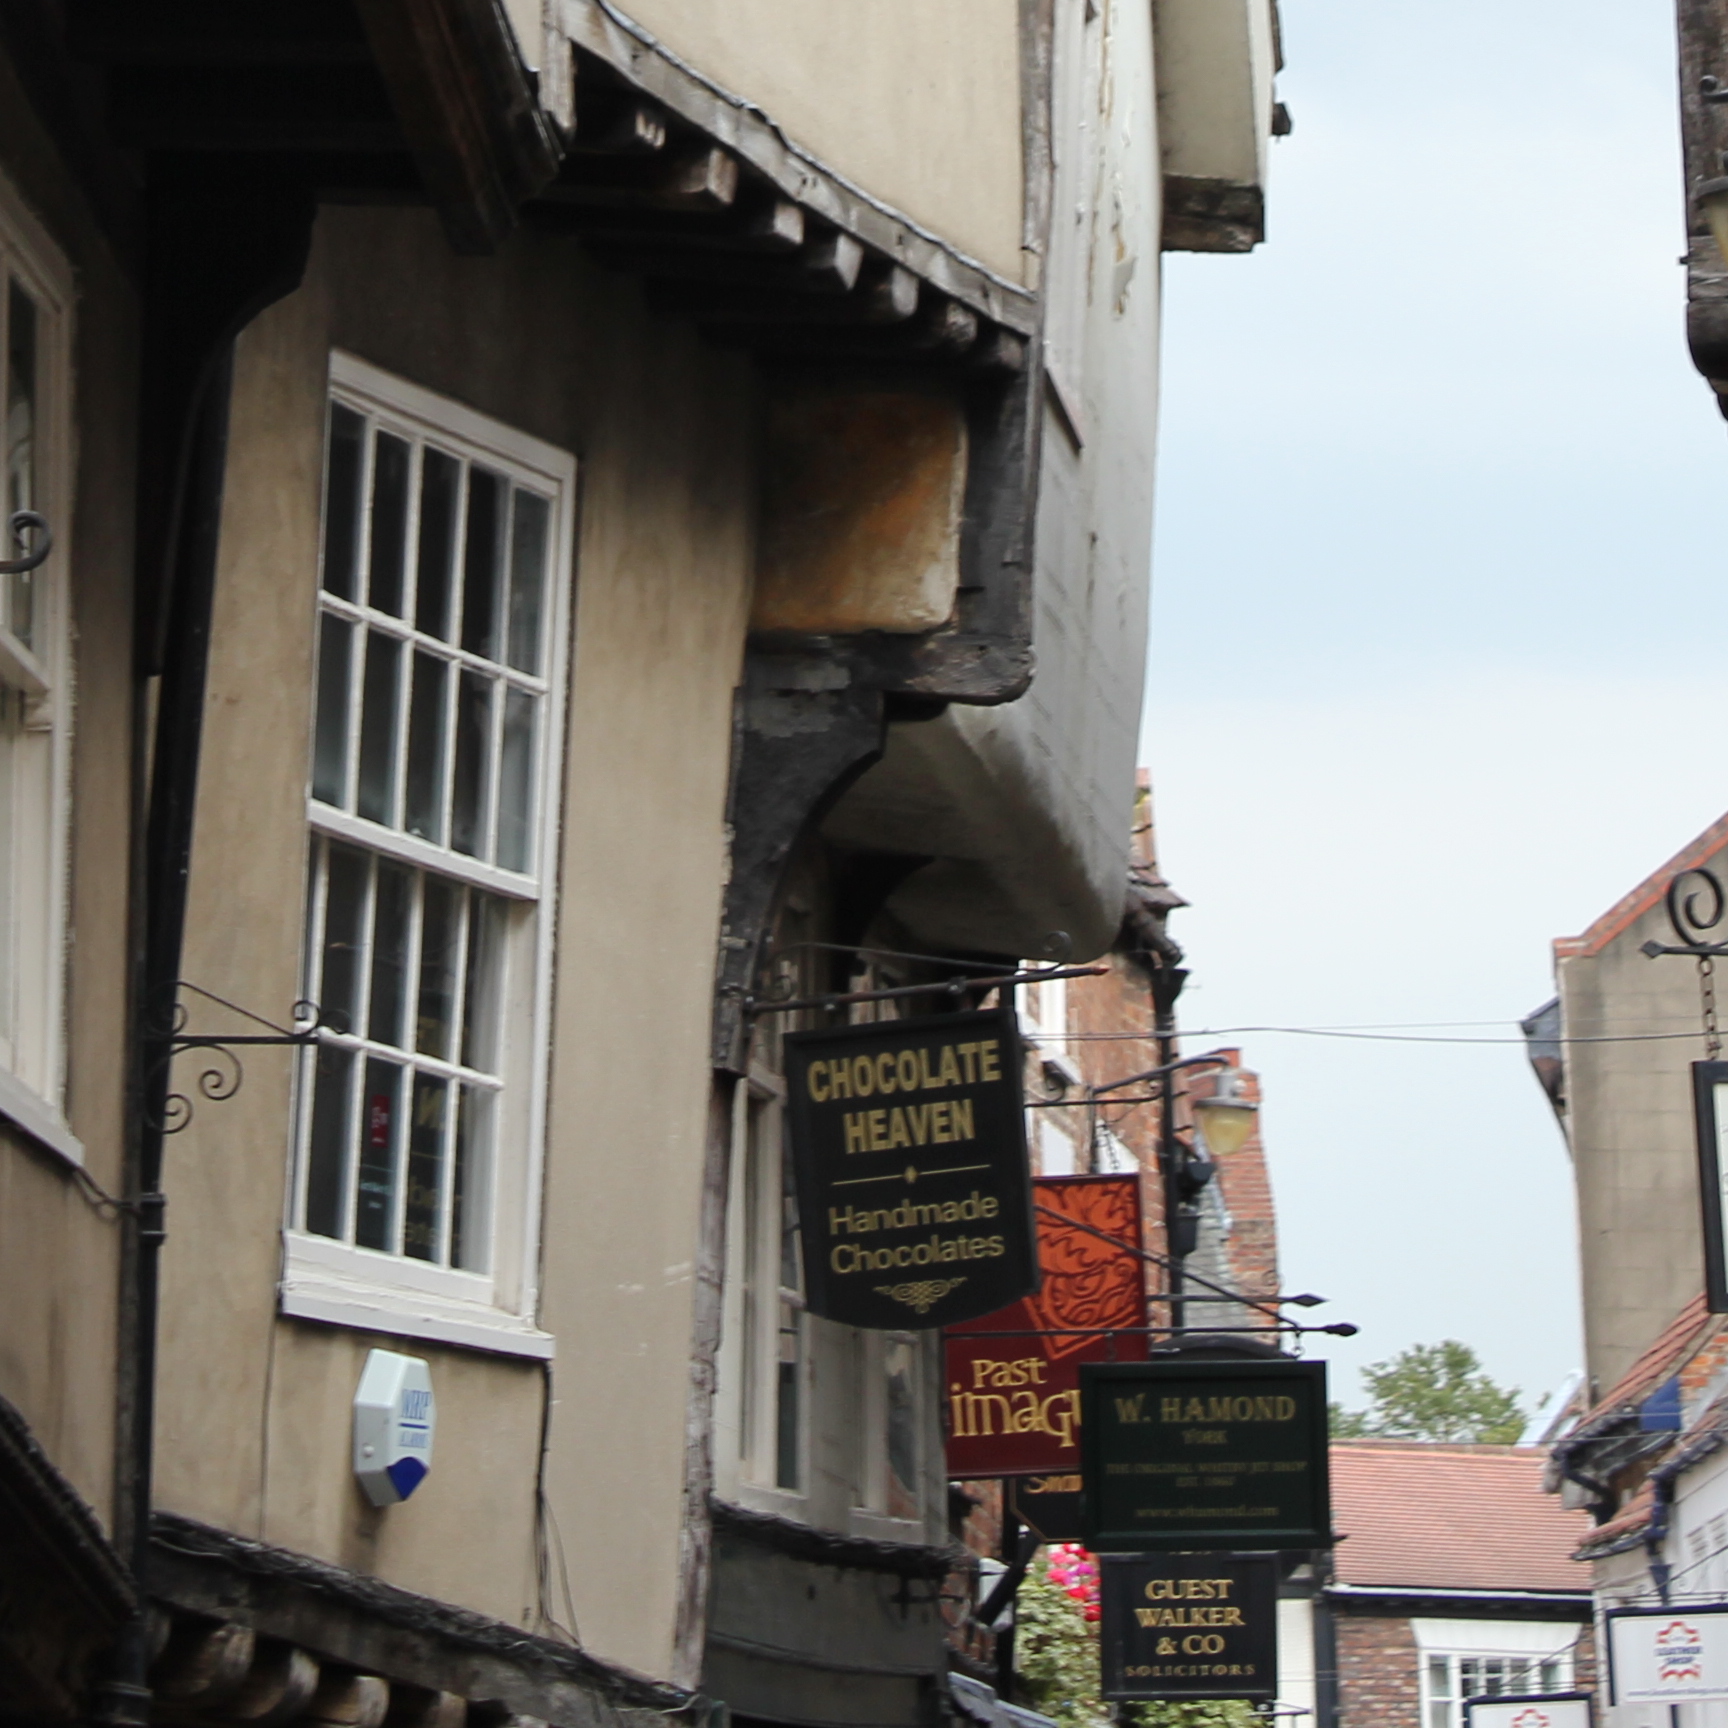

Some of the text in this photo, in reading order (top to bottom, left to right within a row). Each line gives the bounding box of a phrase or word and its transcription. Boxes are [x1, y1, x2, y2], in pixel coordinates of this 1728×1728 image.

[806, 1039, 1003, 1103] CHOCOLATE
[843, 1098, 976, 1154] HEAVEN
[828, 1190, 1000, 1236] Handmade
[829, 1233, 1006, 1274] Chocolates
[970, 1356, 1049, 1389] Past
[1160, 1395, 1297, 1423] HAMOND
[1144, 1579, 1235, 1601] GUEST
[1133, 1606, 1248, 1629] WALKER
[1155, 1634, 1226, 1656] & CO
[1124, 1663, 1256, 1678] SOLICITORS
